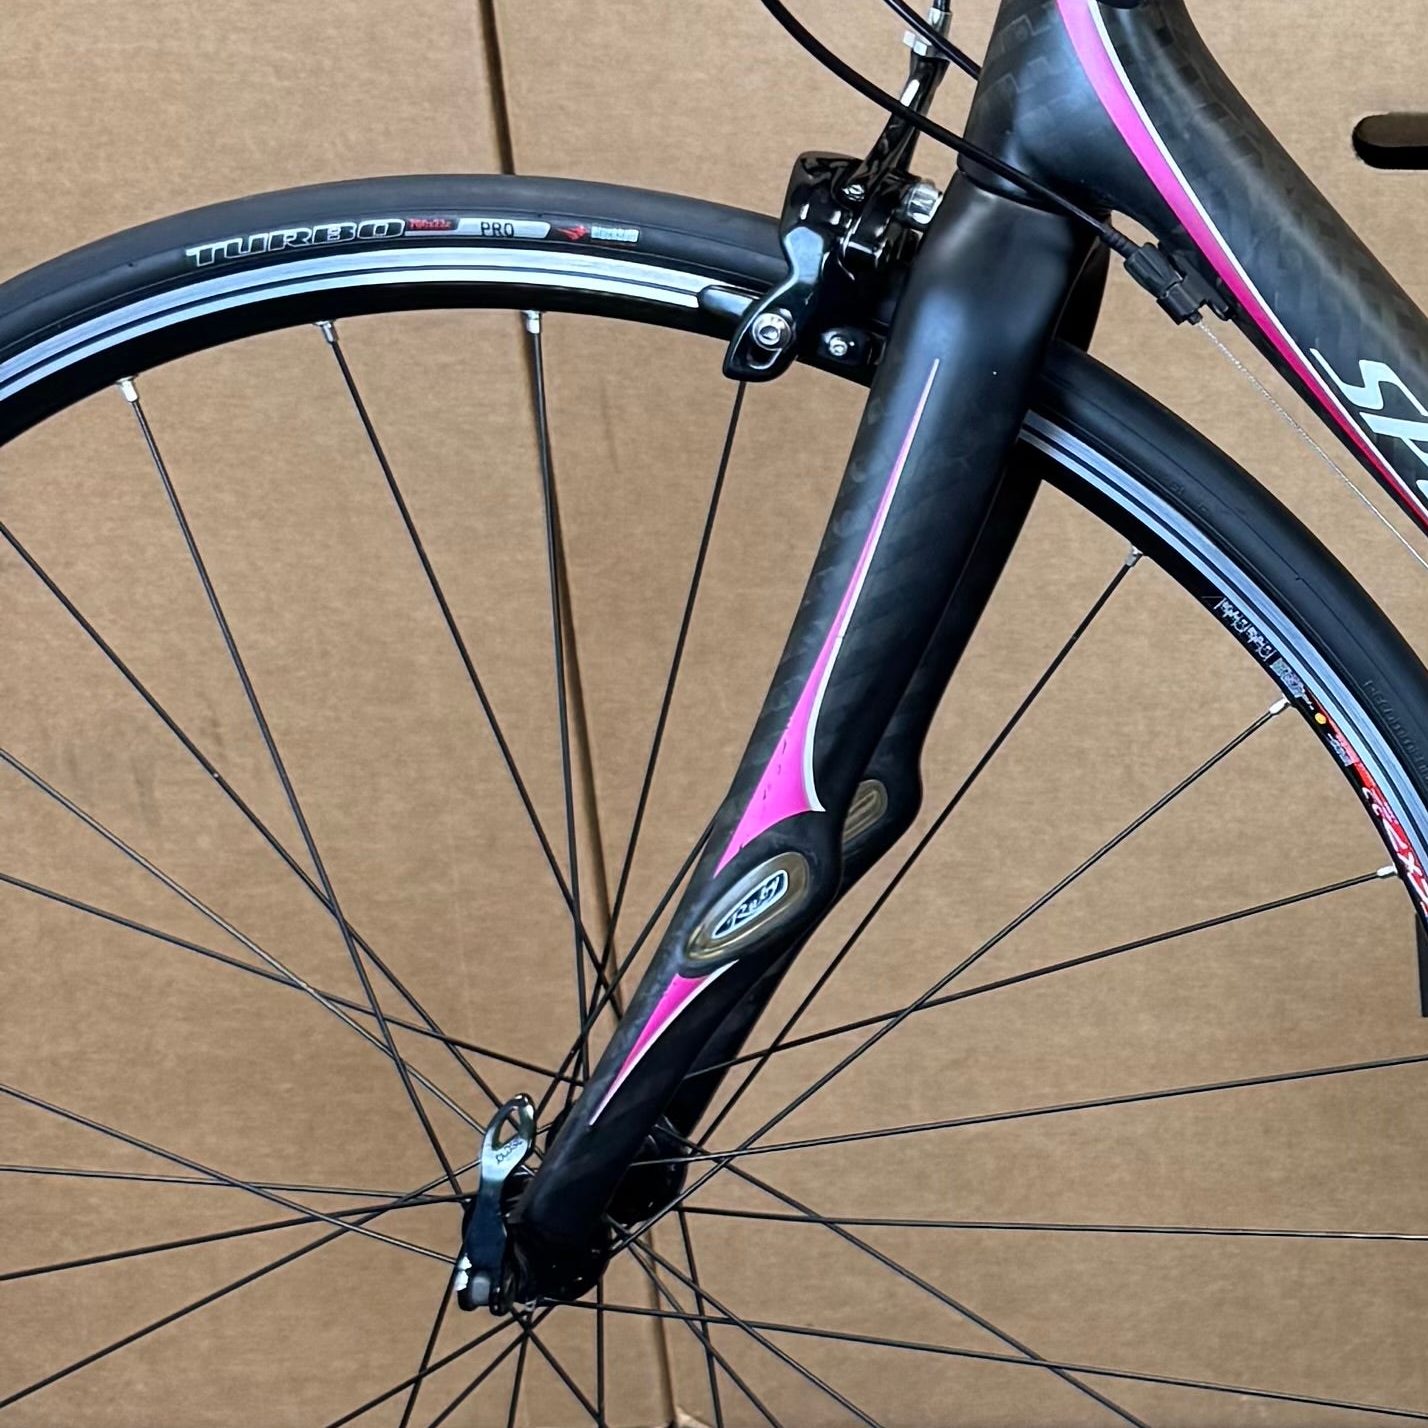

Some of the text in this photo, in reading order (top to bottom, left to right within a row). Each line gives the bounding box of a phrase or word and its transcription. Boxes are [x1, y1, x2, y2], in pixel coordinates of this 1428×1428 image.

[186, 219, 406, 266] TURBO
[480, 220, 515, 238] PRO
[727, 874, 780, 928] Ruby
